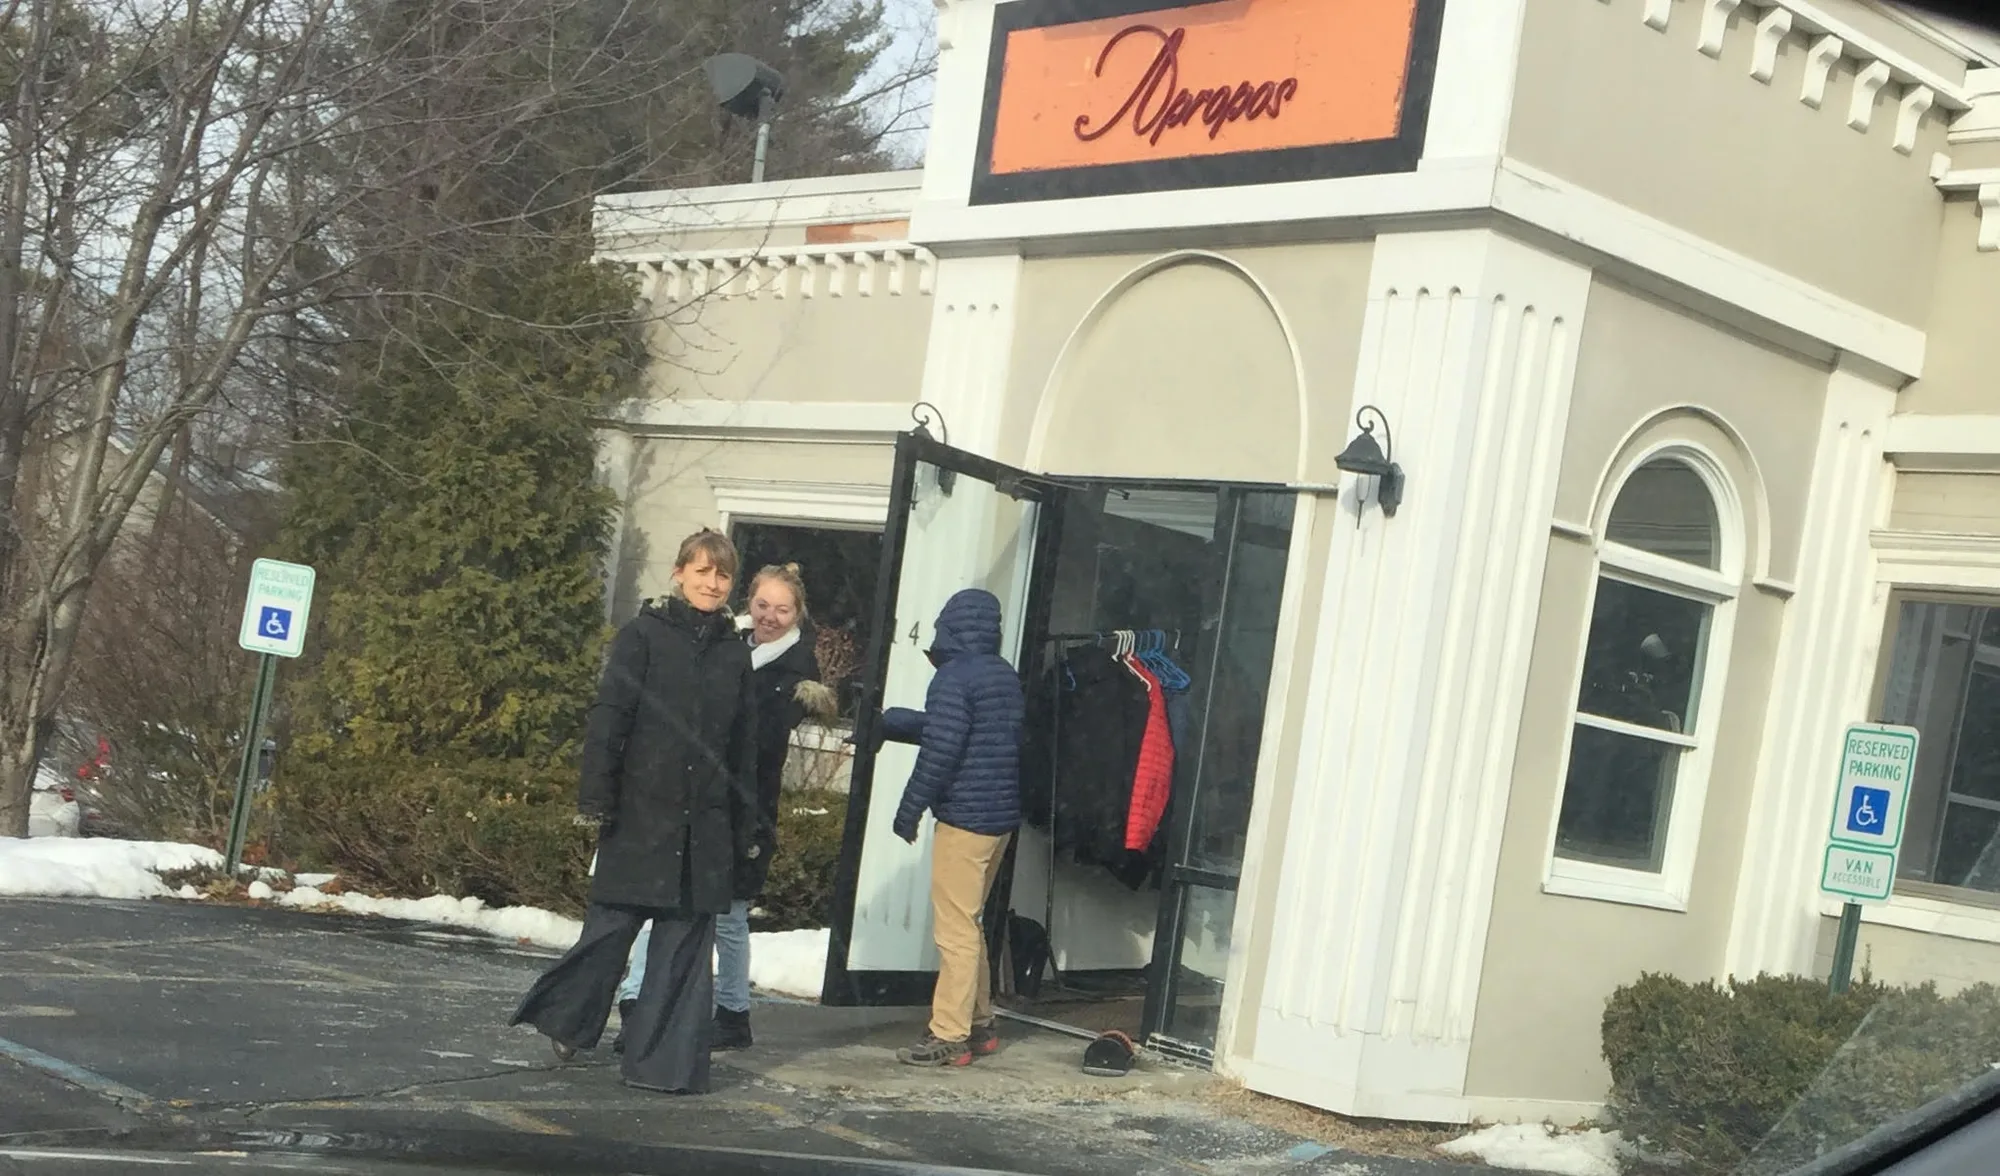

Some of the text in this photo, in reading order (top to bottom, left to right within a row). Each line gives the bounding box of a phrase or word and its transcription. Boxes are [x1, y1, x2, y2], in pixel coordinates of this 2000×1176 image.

[1074, 24, 1298, 147] Apropos
[1848, 739, 1910, 760] RESERVED
[1849, 760, 1902, 781] PARKING
[1846, 858, 1874, 874] VAN
[1832, 872, 1881, 889] ACCESSIBLE
